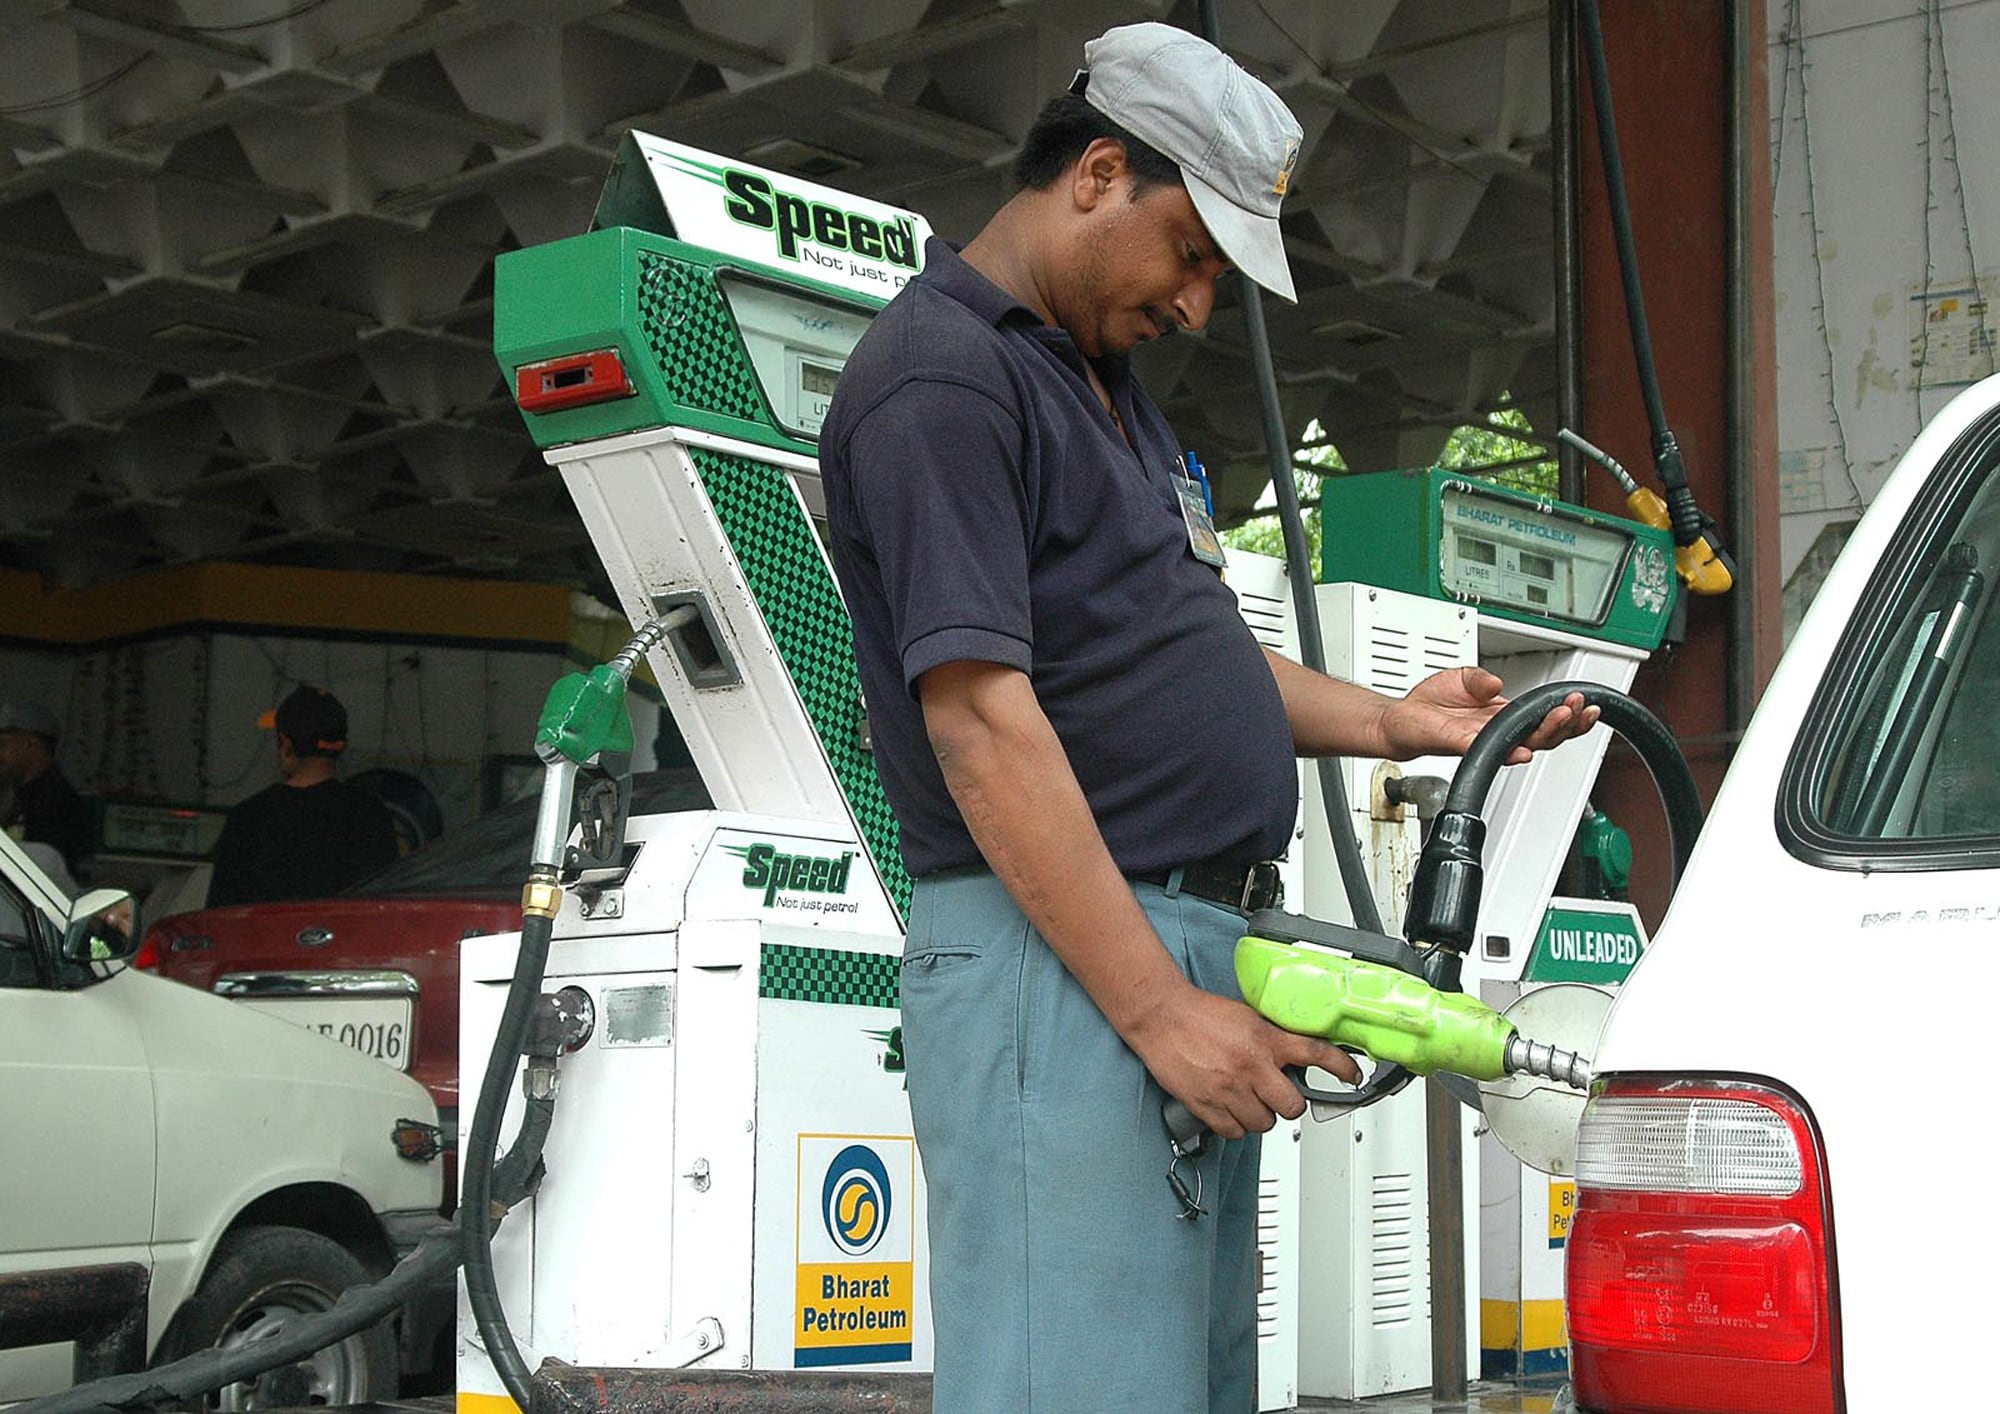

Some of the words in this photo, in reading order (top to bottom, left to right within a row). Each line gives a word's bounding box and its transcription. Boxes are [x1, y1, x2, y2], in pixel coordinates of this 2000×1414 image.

[723, 166, 921, 273] Speed
[803, 247, 843, 271] Not
[849, 260, 888, 283] just
[1457, 505, 1504, 527] BHARAT
[1508, 518, 1576, 546] PETROLEUM
[1465, 566, 1490, 580] LITRES
[742, 842, 853, 909] Speed
[776, 896, 798, 909] Not
[800, 898, 822, 911] just
[823, 902, 859, 915] petrol
[1550, 929, 1637, 965] UNLEADED
[822, 1275, 889, 1299] Bharat
[803, 1305, 906, 1332] Petroleum
